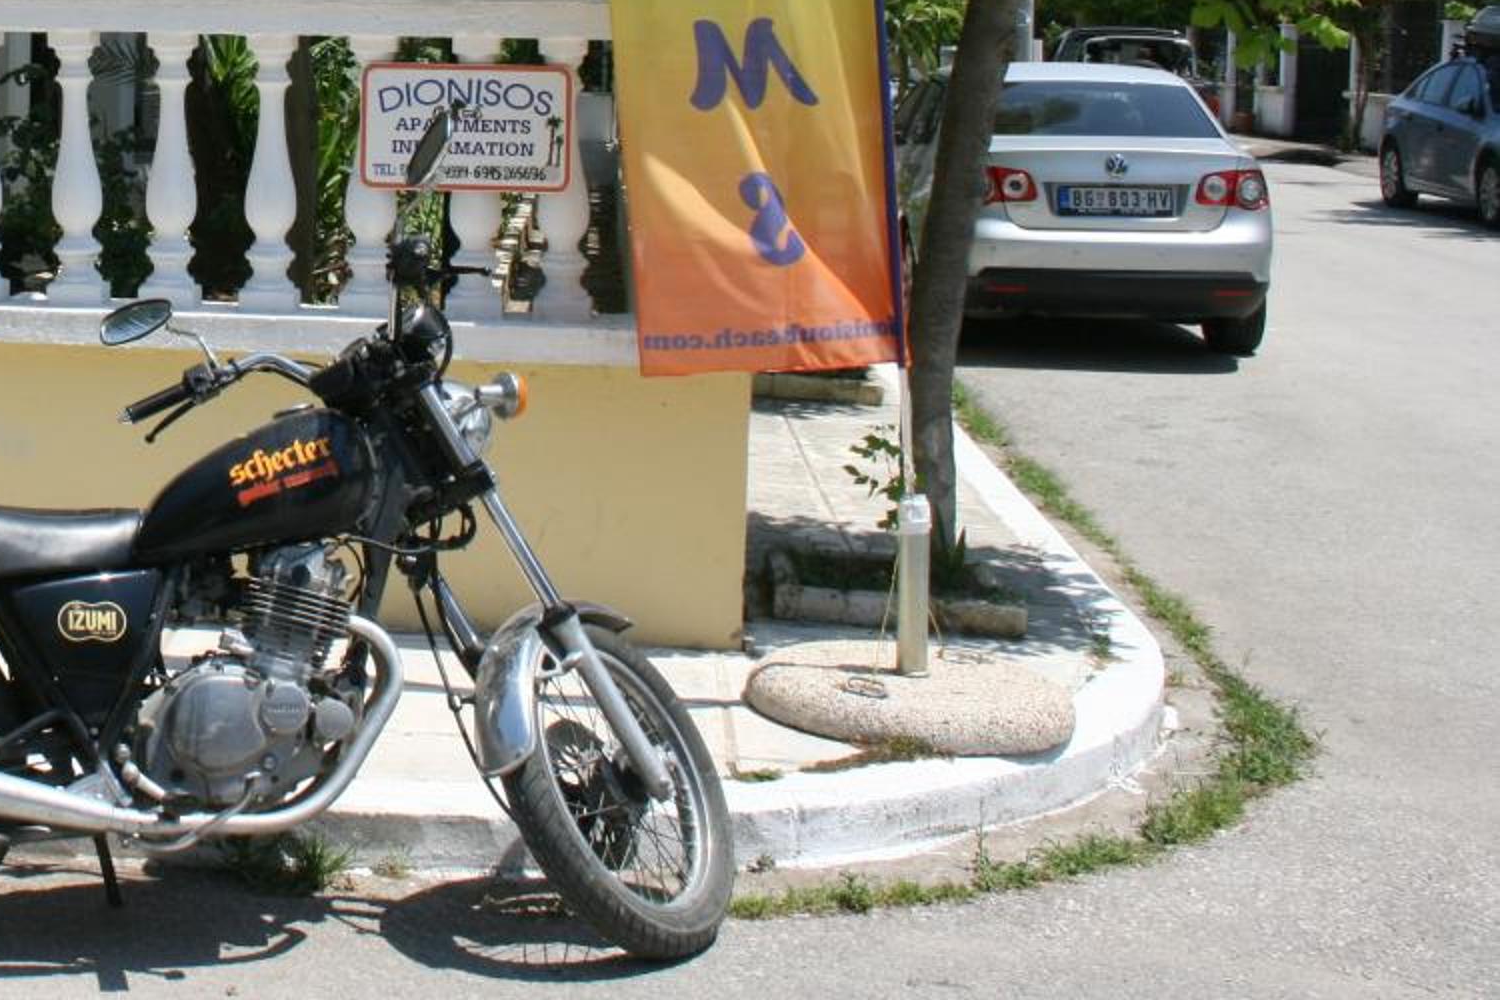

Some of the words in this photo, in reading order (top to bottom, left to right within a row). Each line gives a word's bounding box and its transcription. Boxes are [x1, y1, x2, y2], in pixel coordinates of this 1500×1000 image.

[378, 78, 553, 117] DIONISOS
[395, 117, 532, 134] APATMENTS
[68, 609, 117, 631] IZUMI
